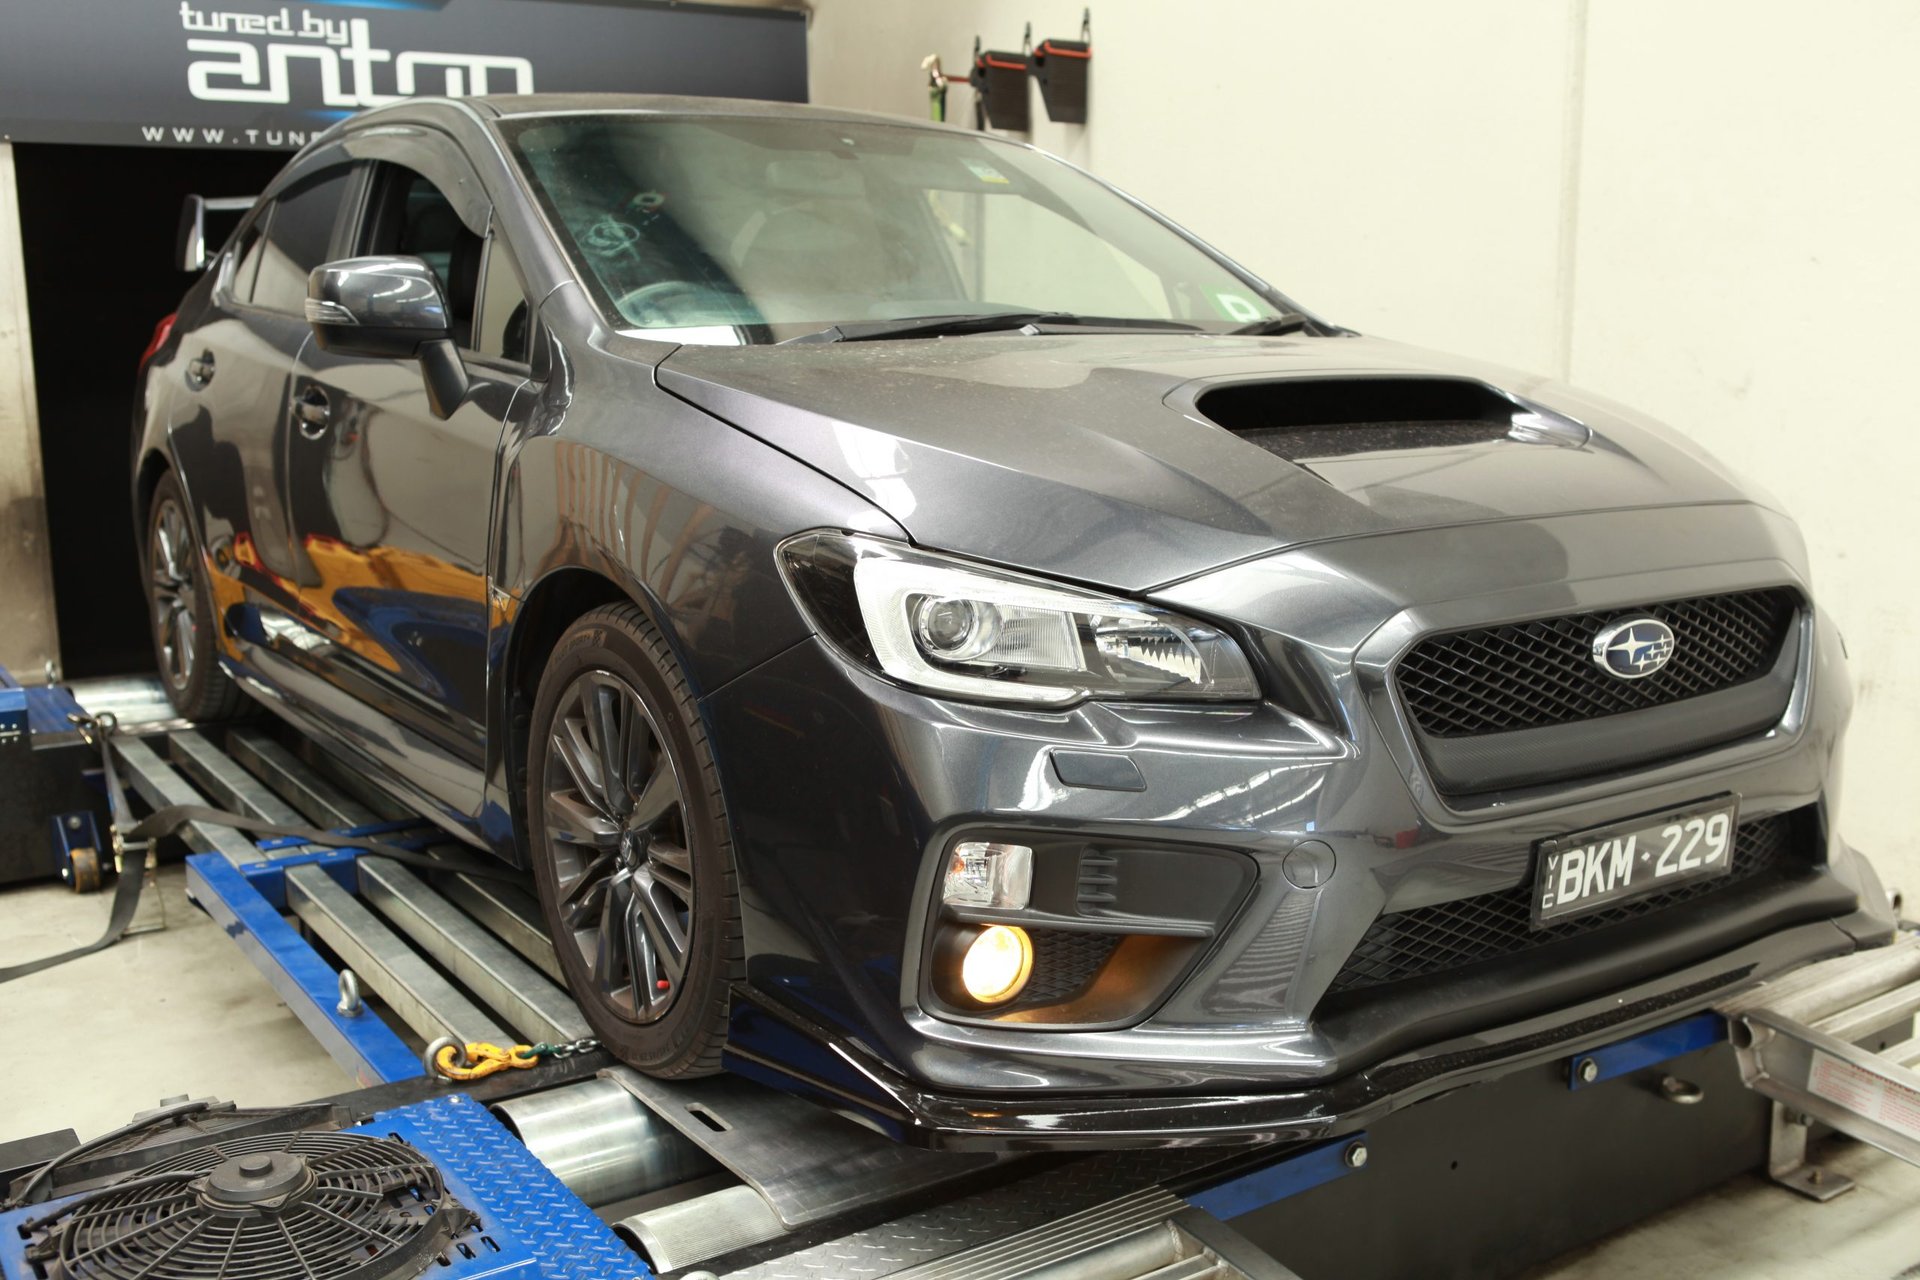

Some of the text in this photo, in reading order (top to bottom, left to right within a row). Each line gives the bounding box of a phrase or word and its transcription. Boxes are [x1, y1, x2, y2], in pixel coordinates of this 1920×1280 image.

[179, 1, 348, 44] tuned by
[1541, 854, 1559, 909] VIC
[1556, 813, 1729, 905] BKM 229
